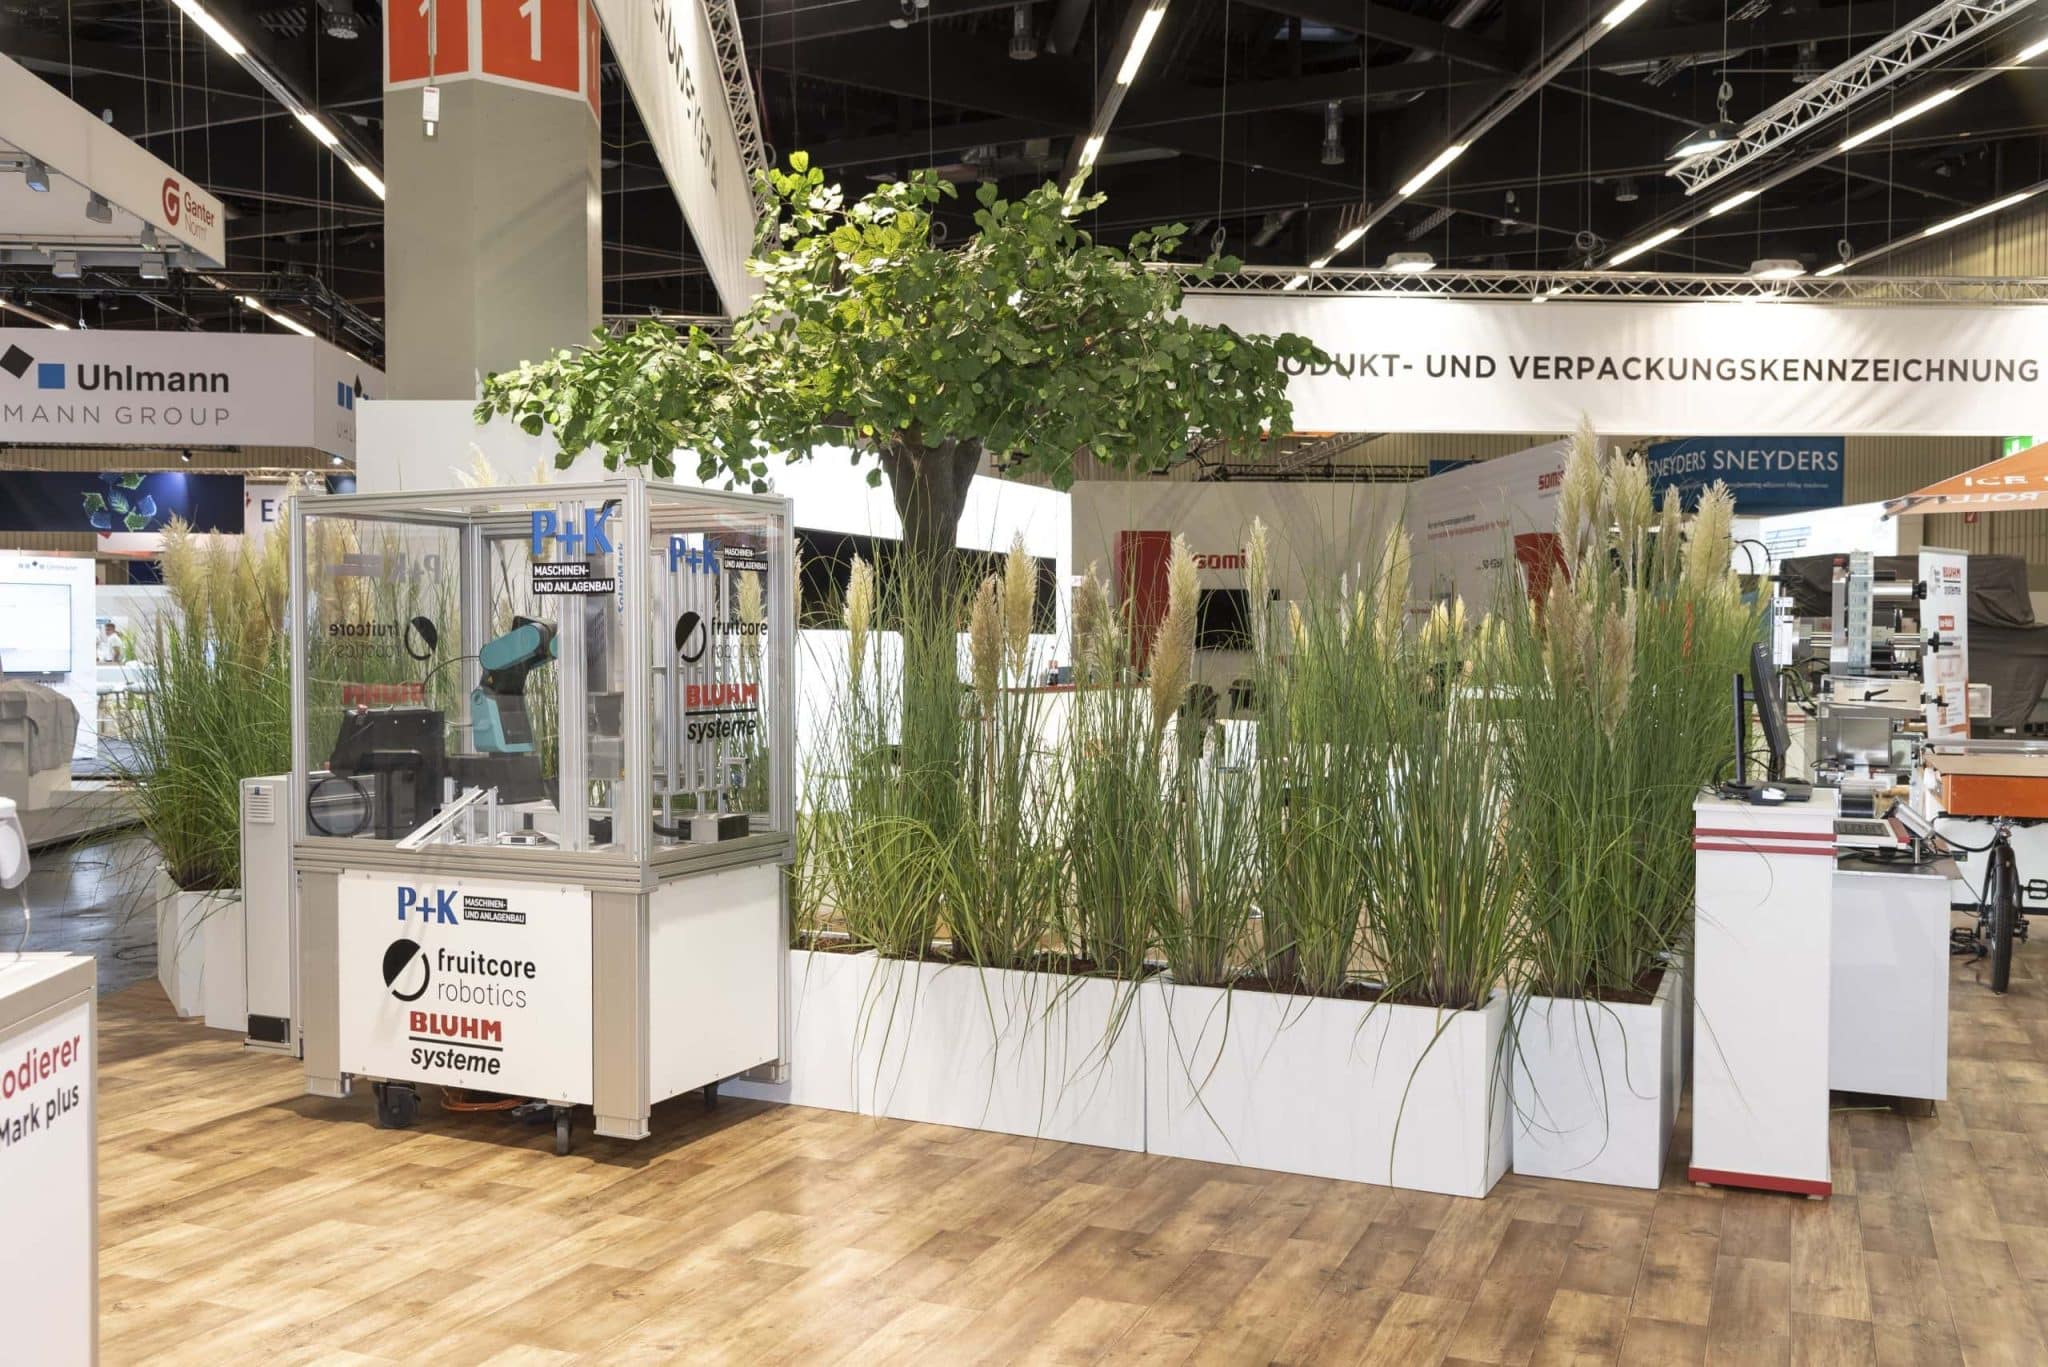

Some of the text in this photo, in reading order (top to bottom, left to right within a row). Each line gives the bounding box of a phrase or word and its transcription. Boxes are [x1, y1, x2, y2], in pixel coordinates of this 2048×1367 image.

[519, 0, 542, 62] 1
[184, 191, 215, 228] Ganter
[77, 363, 230, 393] Uhlmann
[1426, 354, 1497, 379] UND
[1508, 355, 2040, 382] VERPACKUNGSKENNZEICHNUNG
[3, 404, 230, 426] MANN GROUP
[1712, 449, 1839, 472] SNEYDERS
[1964, 475, 2029, 487] ICE
[531, 506, 615, 555] P+K
[669, 535, 721, 576] P+K
[534, 564, 590, 577] MASCHINEN-
[534, 580, 614, 593] UND ANLAGENBAU
[711, 617, 768, 636] fruitcore
[686, 682, 759, 708] BLUHM
[687, 718, 757, 744] systeme
[397, 886, 460, 926] P+K
[464, 897, 507, 910] MASCHINEN-
[464, 910, 526, 924] UND ANLAGENBAU
[438, 947, 537, 980] fruitcore
[438, 978, 528, 1009] robotics
[409, 1010, 503, 1043] BLUHM
[410, 1047, 502, 1076] systeme
[46, 1084, 80, 1130] plus
